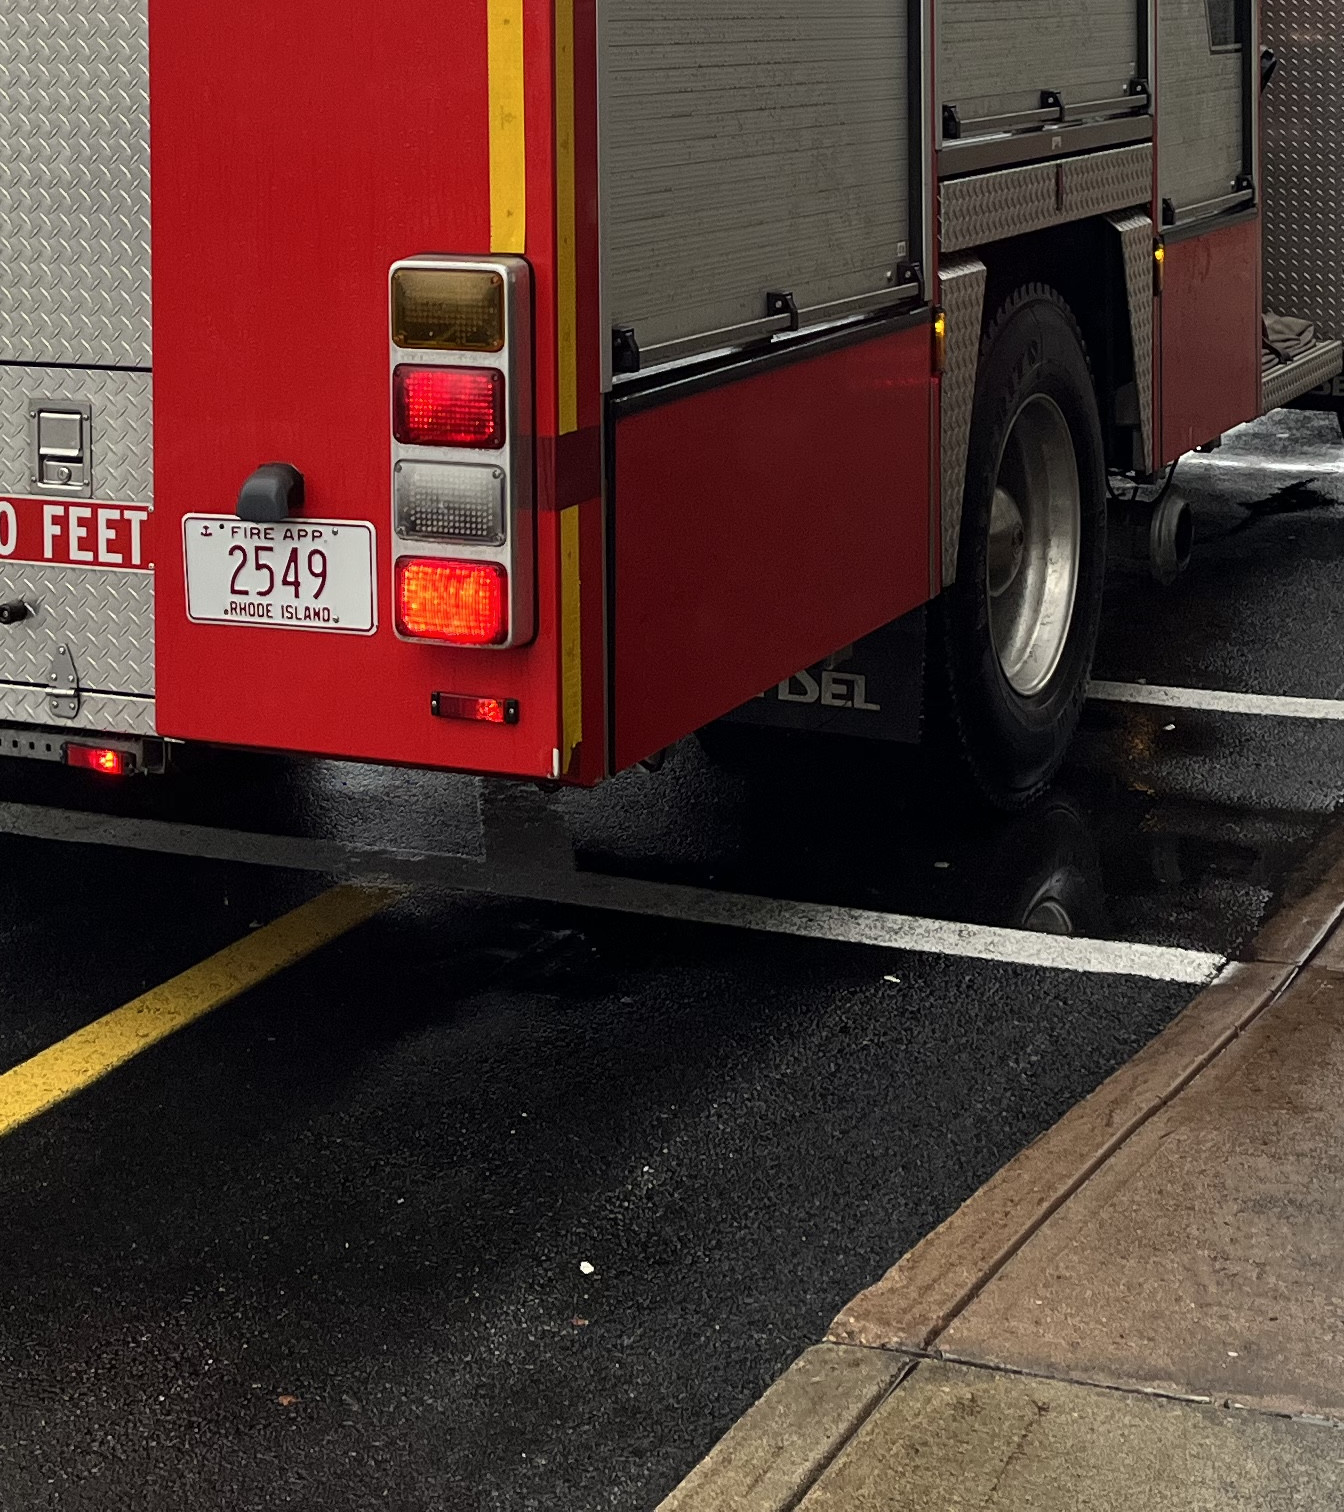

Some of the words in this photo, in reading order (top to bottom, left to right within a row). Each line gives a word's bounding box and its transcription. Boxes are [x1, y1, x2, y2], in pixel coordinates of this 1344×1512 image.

[43, 505, 149, 566] FEET
[230, 525, 275, 541] FIRE
[227, 544, 328, 600] 2549
[229, 600, 273, 619] RHODE
[280, 604, 332, 623] ISLAND
